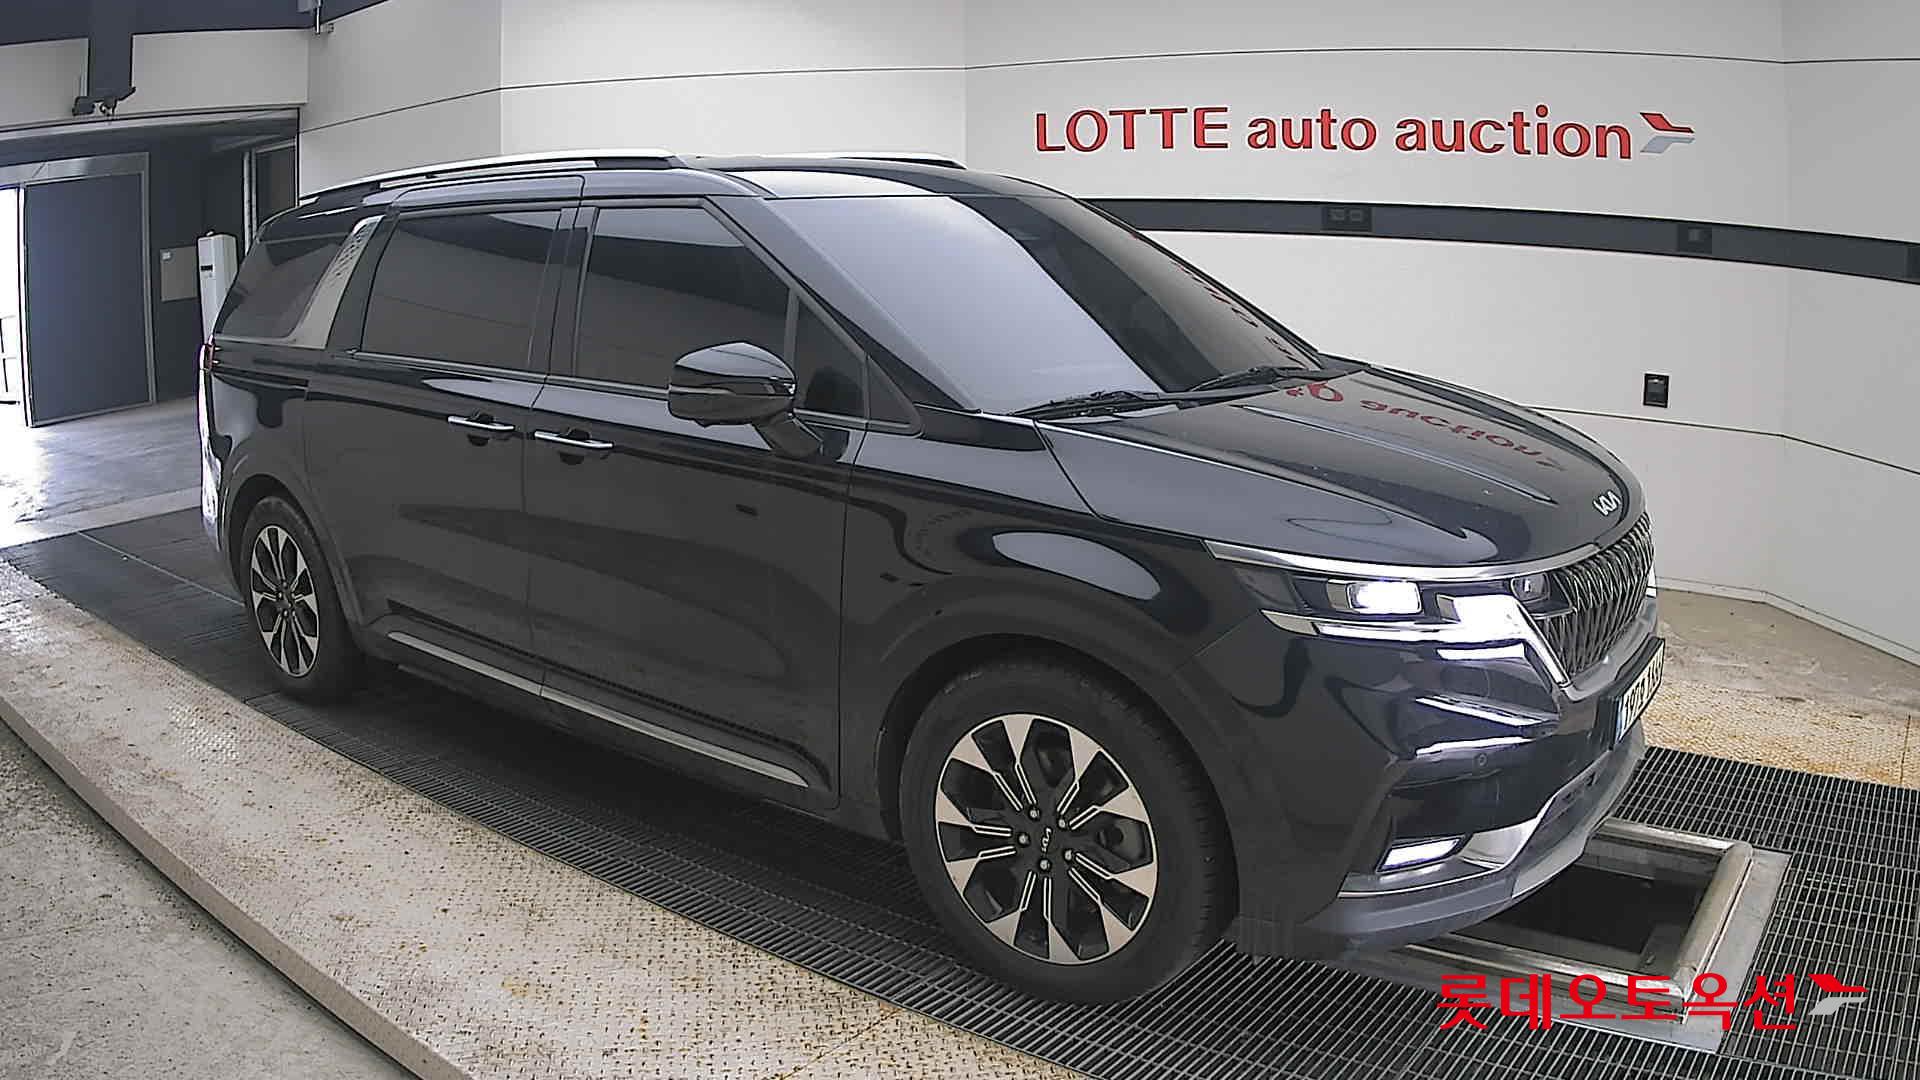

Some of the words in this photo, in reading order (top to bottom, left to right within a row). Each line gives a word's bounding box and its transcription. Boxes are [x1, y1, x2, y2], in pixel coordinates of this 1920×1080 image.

[1035, 106, 1229, 153] LOTTE
[1247, 106, 1378, 152] auto
[1394, 104, 1633, 160] auction
